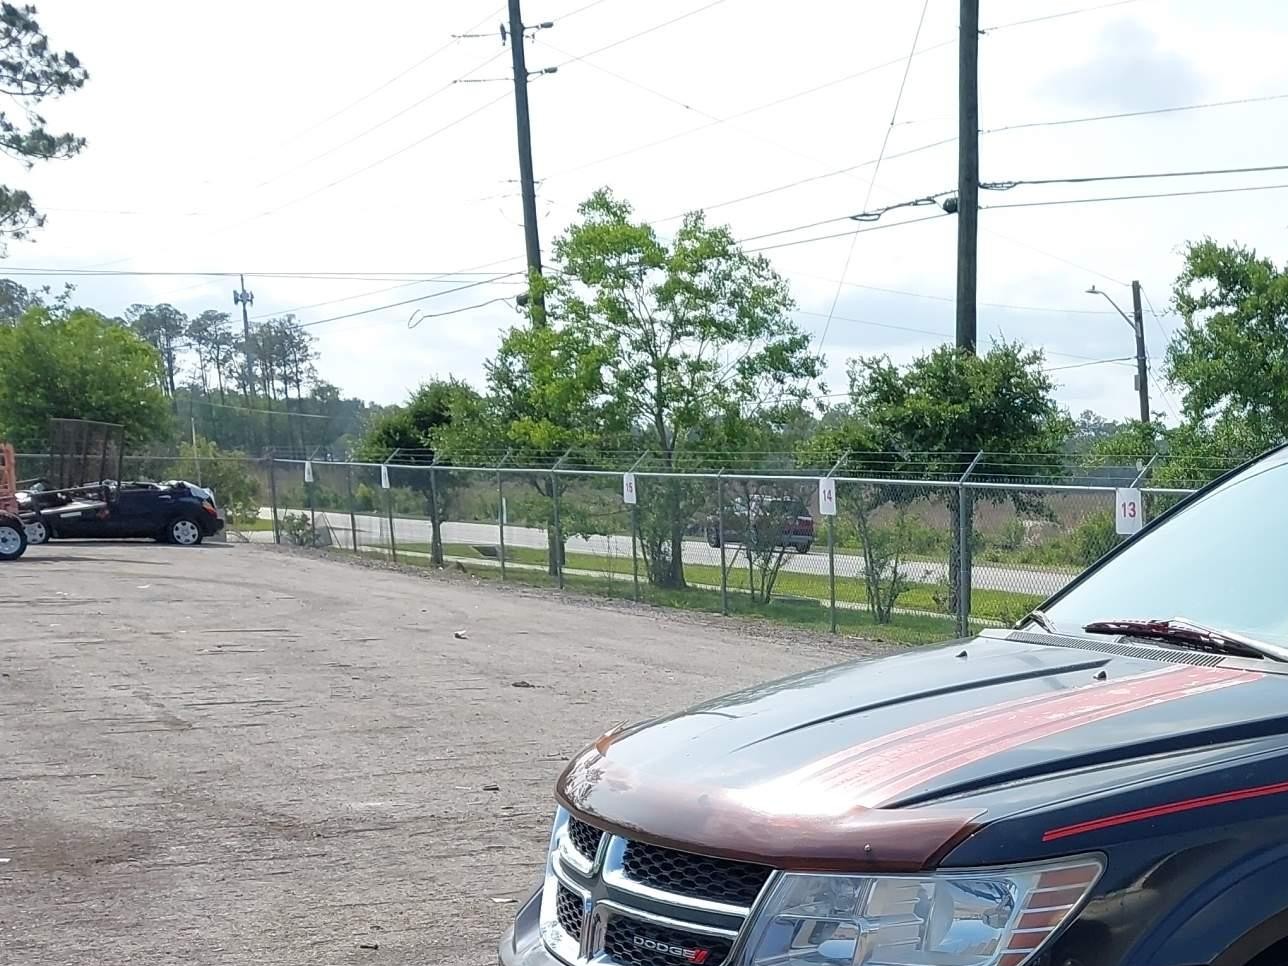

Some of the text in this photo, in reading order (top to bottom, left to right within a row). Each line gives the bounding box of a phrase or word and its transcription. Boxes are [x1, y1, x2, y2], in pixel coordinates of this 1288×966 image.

[823, 489, 832, 502] 14
[1121, 501, 1137, 518] 13
[633, 936, 696, 959] DODGE
